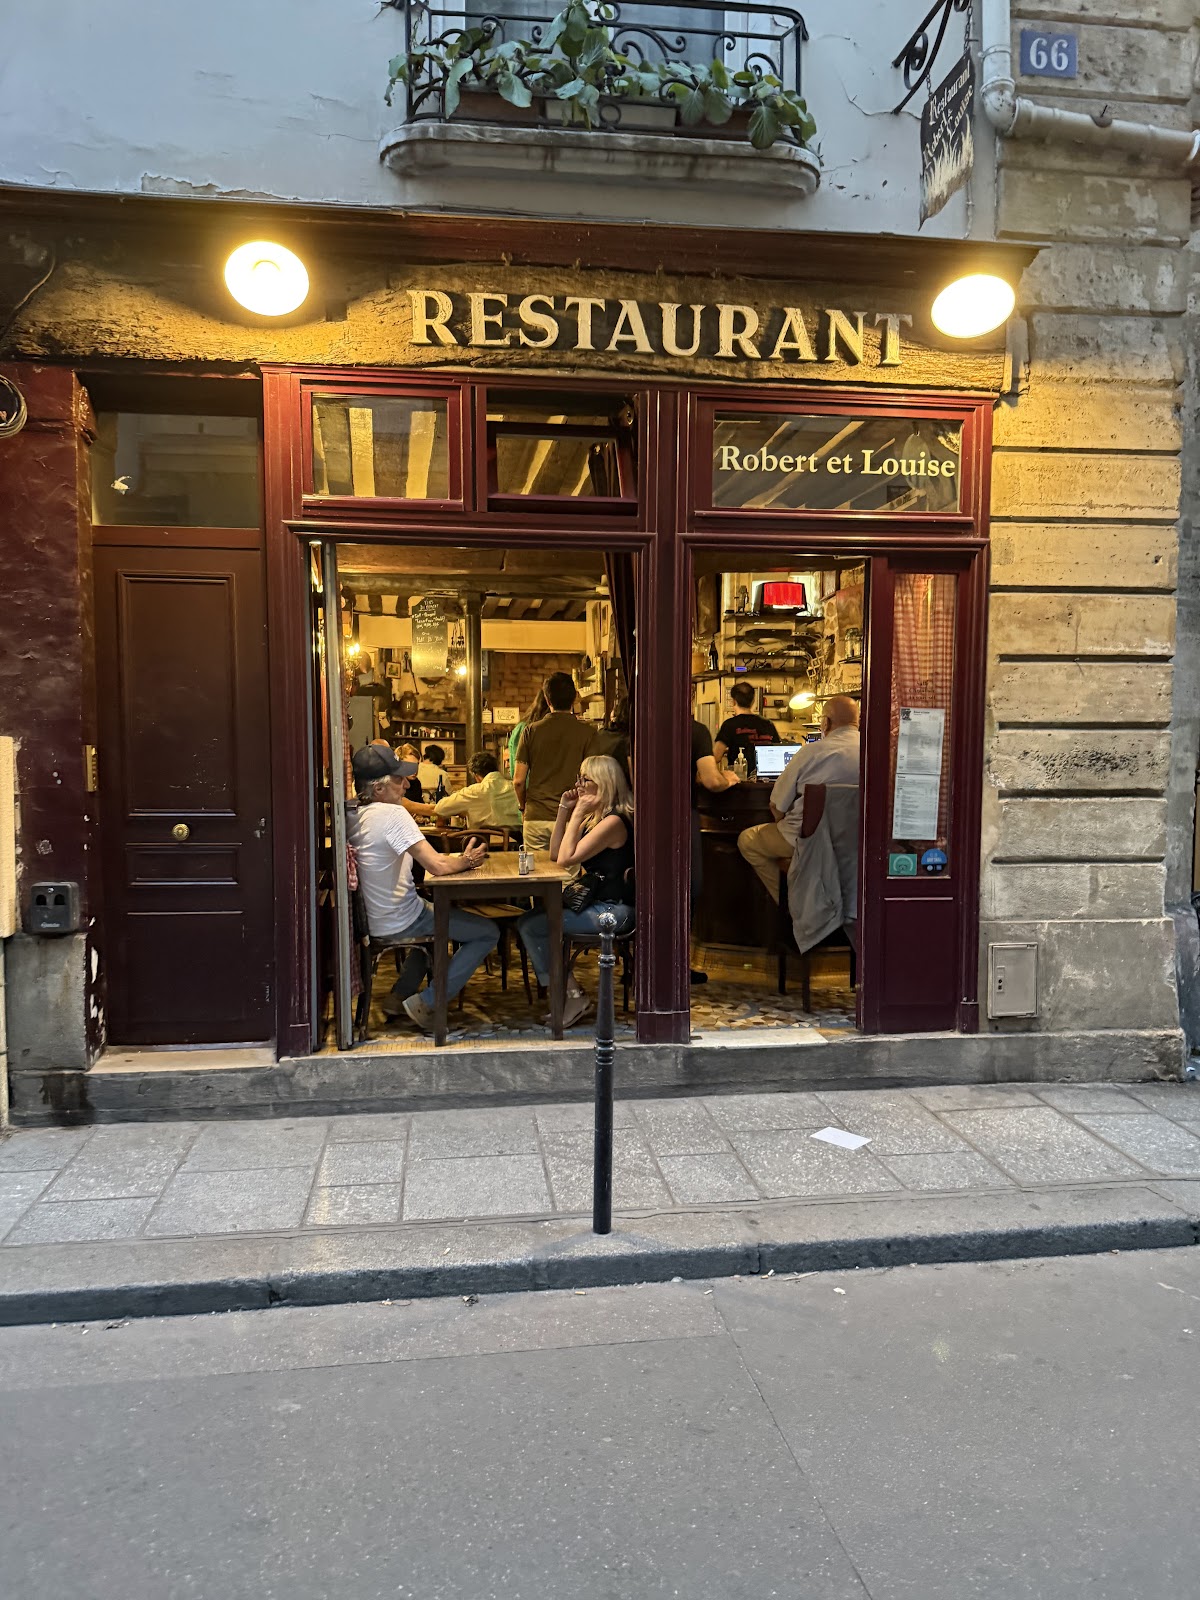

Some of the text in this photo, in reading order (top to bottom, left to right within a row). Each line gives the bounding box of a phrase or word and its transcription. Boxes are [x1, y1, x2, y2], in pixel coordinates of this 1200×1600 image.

[1029, 37, 1069, 72] 66
[405, 289, 913, 366] RESTAURANT
[719, 445, 956, 477] Robert et Louise
